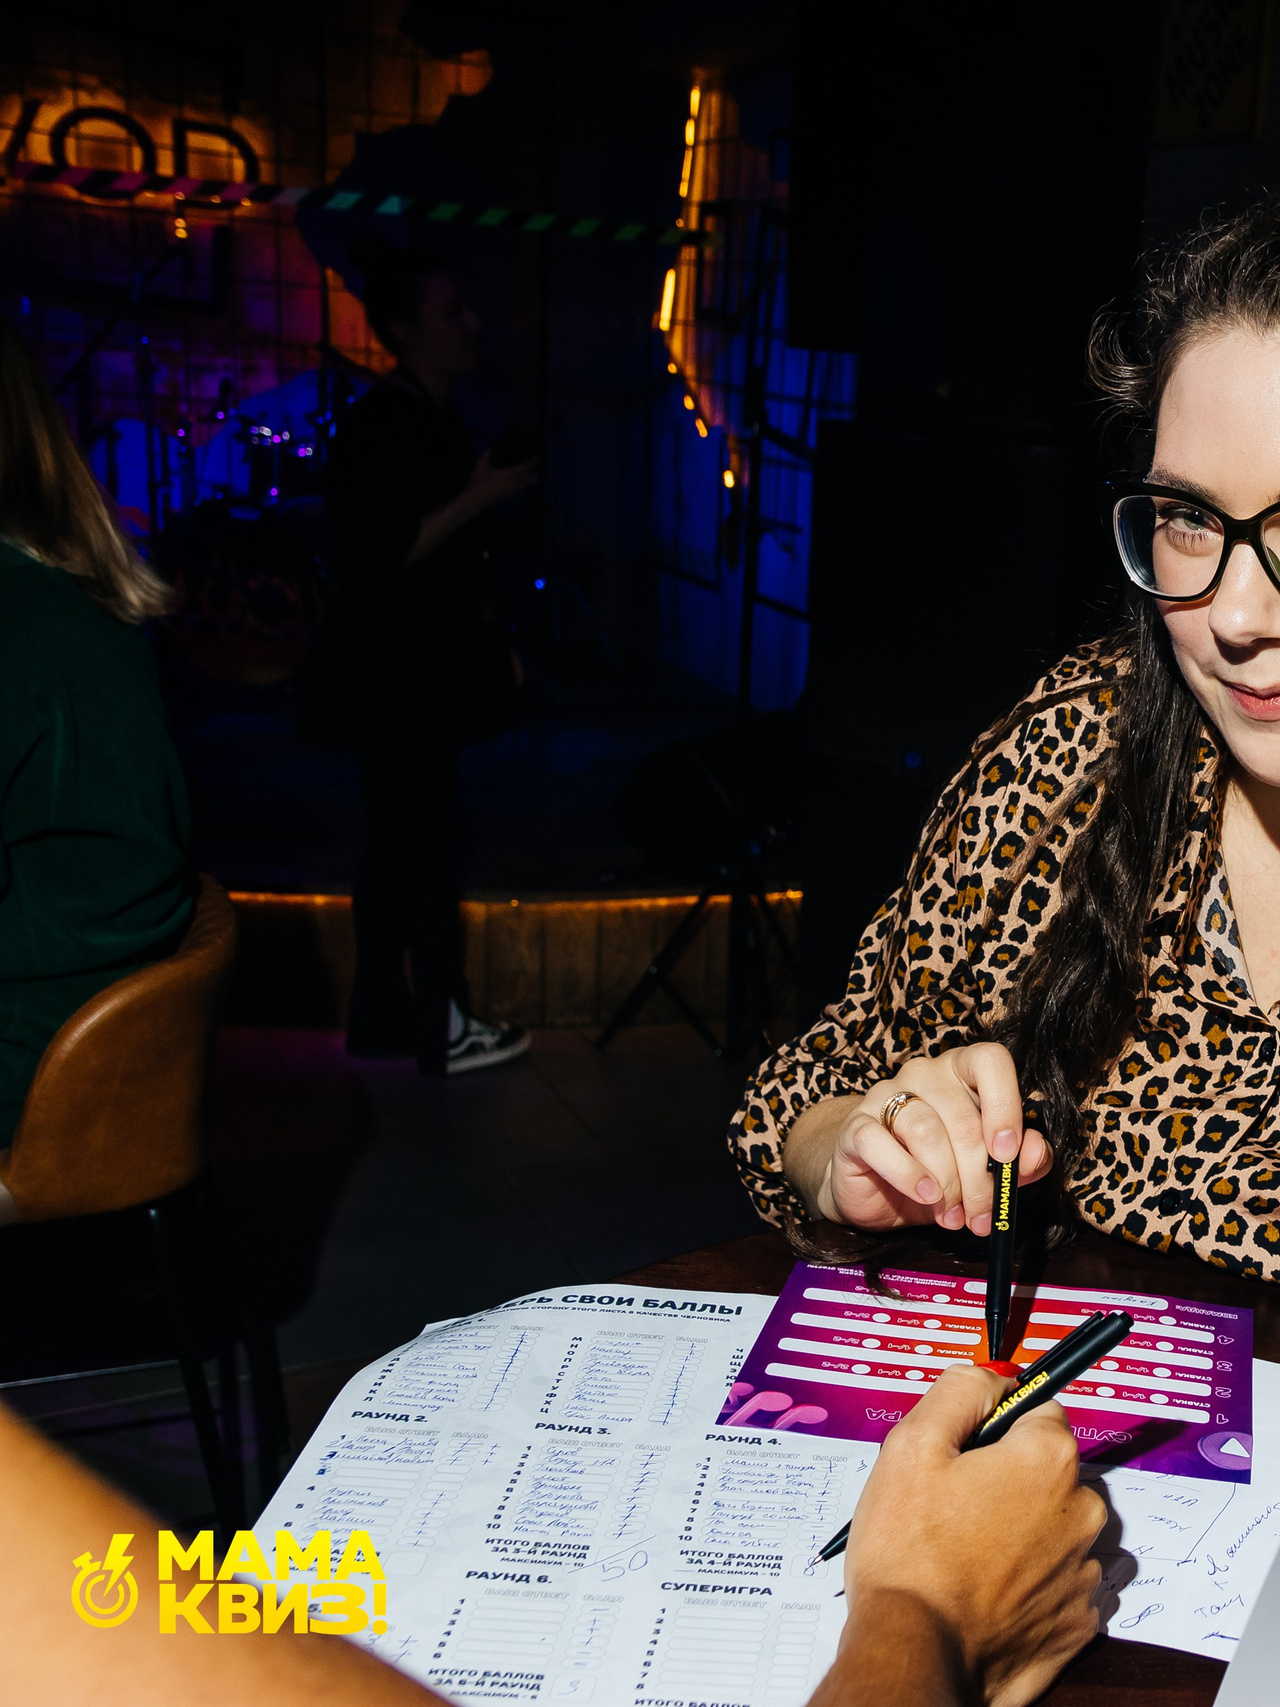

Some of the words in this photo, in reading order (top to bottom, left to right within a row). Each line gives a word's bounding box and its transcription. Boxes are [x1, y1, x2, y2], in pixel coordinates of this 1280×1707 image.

[999, 1162, 1012, 1220] МАМАКВИ
[561, 1294, 635, 1307] СВОИ
[642, 1298, 743, 1316] БАЛЛЫ
[954, 1297, 986, 1306] ТАВКА:
[1175, 1304, 1238, 1320] КОМАНДА:
[681, 1314, 731, 1323] ЧЕРНОВИКА
[945, 1322, 982, 1331] СТАВКА:
[1179, 1319, 1216, 1331] СТАВКА:
[1217, 1334, 1234, 1345] 4
[936, 1348, 974, 1357] СТАВКА:
[1177, 1345, 1214, 1356] СТАВКА:
[1217, 1359, 1233, 1372] 3
[1175, 1371, 1213, 1382] СТАВКА:
[1215, 1386, 1232, 1398] 2
[1172, 1397, 1211, 1408] СТАВКА:
[351, 1410, 410, 1423] РАУНД
[413, 1415, 429, 1423] 2.
[1216, 1413, 1229, 1425] 1
[535, 1422, 592, 1435] РАУНД
[597, 1426, 611, 1435] 3.
[704, 1433, 763, 1445] РАУНД
[766, 1437, 783, 1446] 4.
[484, 1538, 530, 1547] ИТОГО
[533, 1541, 591, 1551] БАЛЛОВ
[512, 1546, 538, 1555] 3-Й
[541, 1550, 587, 1560] РАУНД
[679, 1549, 723, 1559] ИТОГО
[727, 1552, 783, 1561] БАЛЛОВ
[500, 1557, 563, 1567] МАКСИМУМ
[685, 1557, 703, 1565] ЗА
[707, 1558, 733, 1566] 4-Й
[736, 1560, 782, 1569] РАУНД
[465, 1570, 530, 1584] РАУНД
[536, 1574, 553, 1584] 6.
[697, 1568, 759, 1577] МАКСИМУМ
[660, 1581, 773, 1596] СУПЕРИГРА
[428, 1668, 478, 1678] ИТОГО
[482, 1671, 545, 1681] БАЛЛОВ
[434, 1678, 453, 1686] ЗА
[490, 1681, 541, 1691] РАУНД
[449, 1689, 520, 1699] МАКСИМУМ
[634, 1698, 684, 1707] ИТОГО
